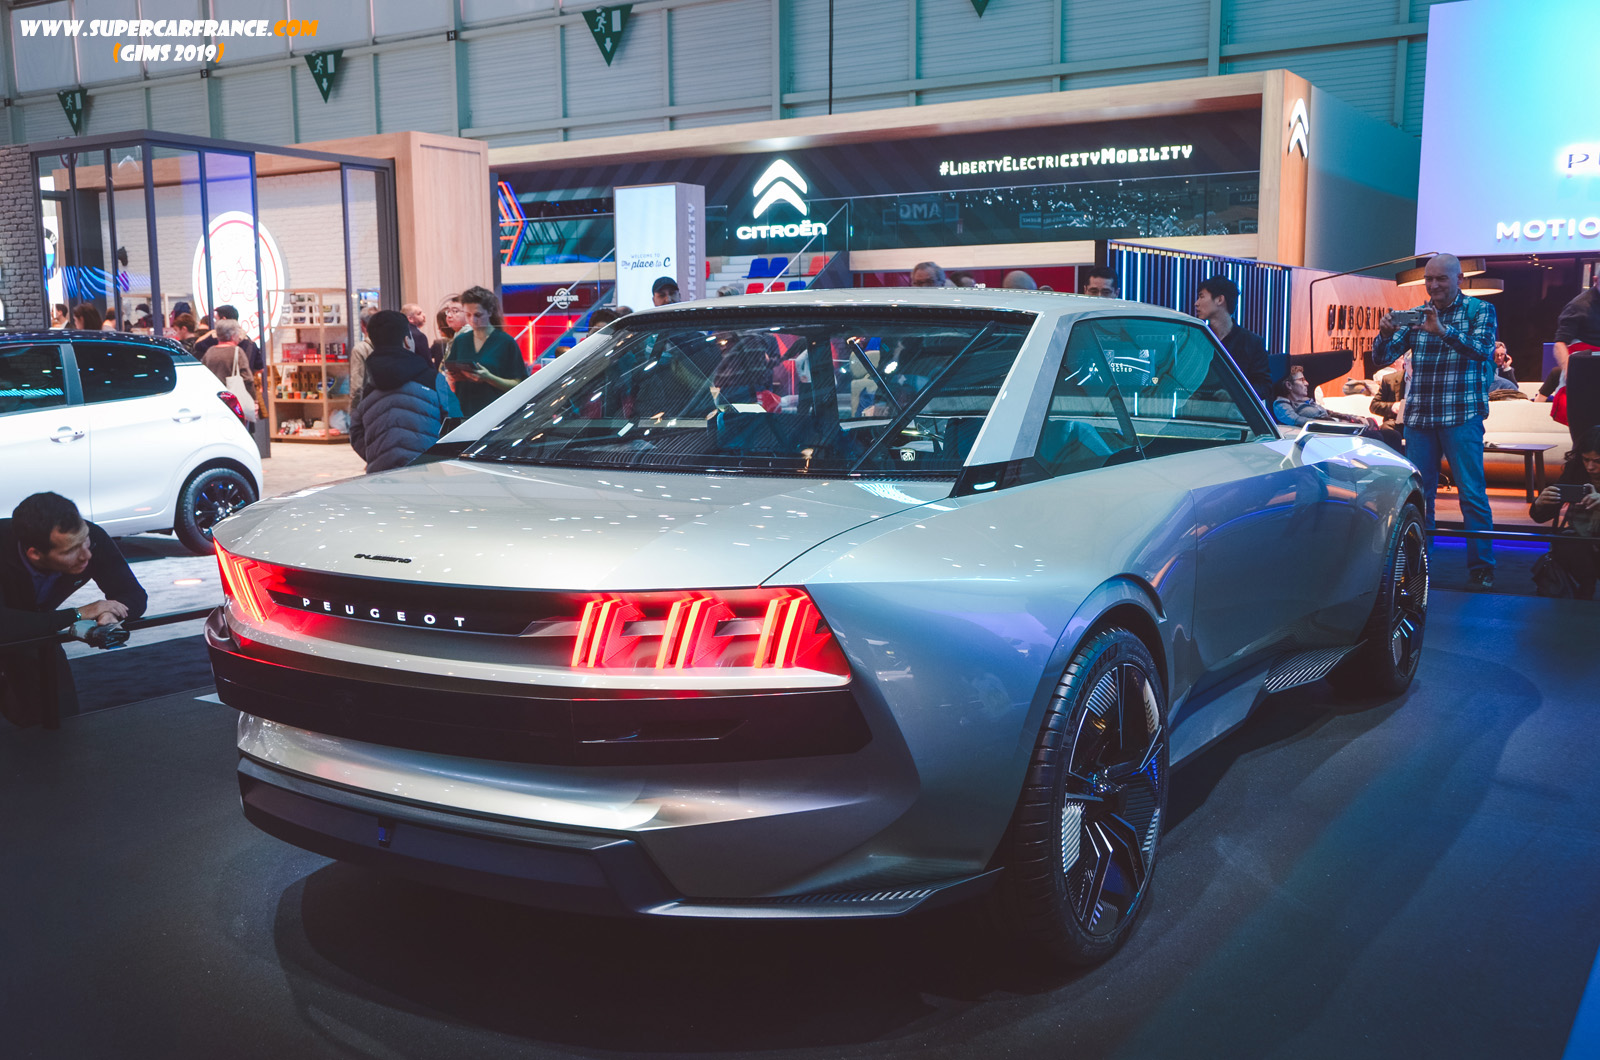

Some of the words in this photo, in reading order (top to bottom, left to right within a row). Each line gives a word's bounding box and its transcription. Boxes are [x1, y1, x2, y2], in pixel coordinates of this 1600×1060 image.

[736, 219, 828, 240] CITROËN
[630, 259, 654, 271] place
[663, 256, 671, 268] C
[1327, 304, 1385, 331] UNBORIN
[302, 597, 465, 628] PEUGEOT
